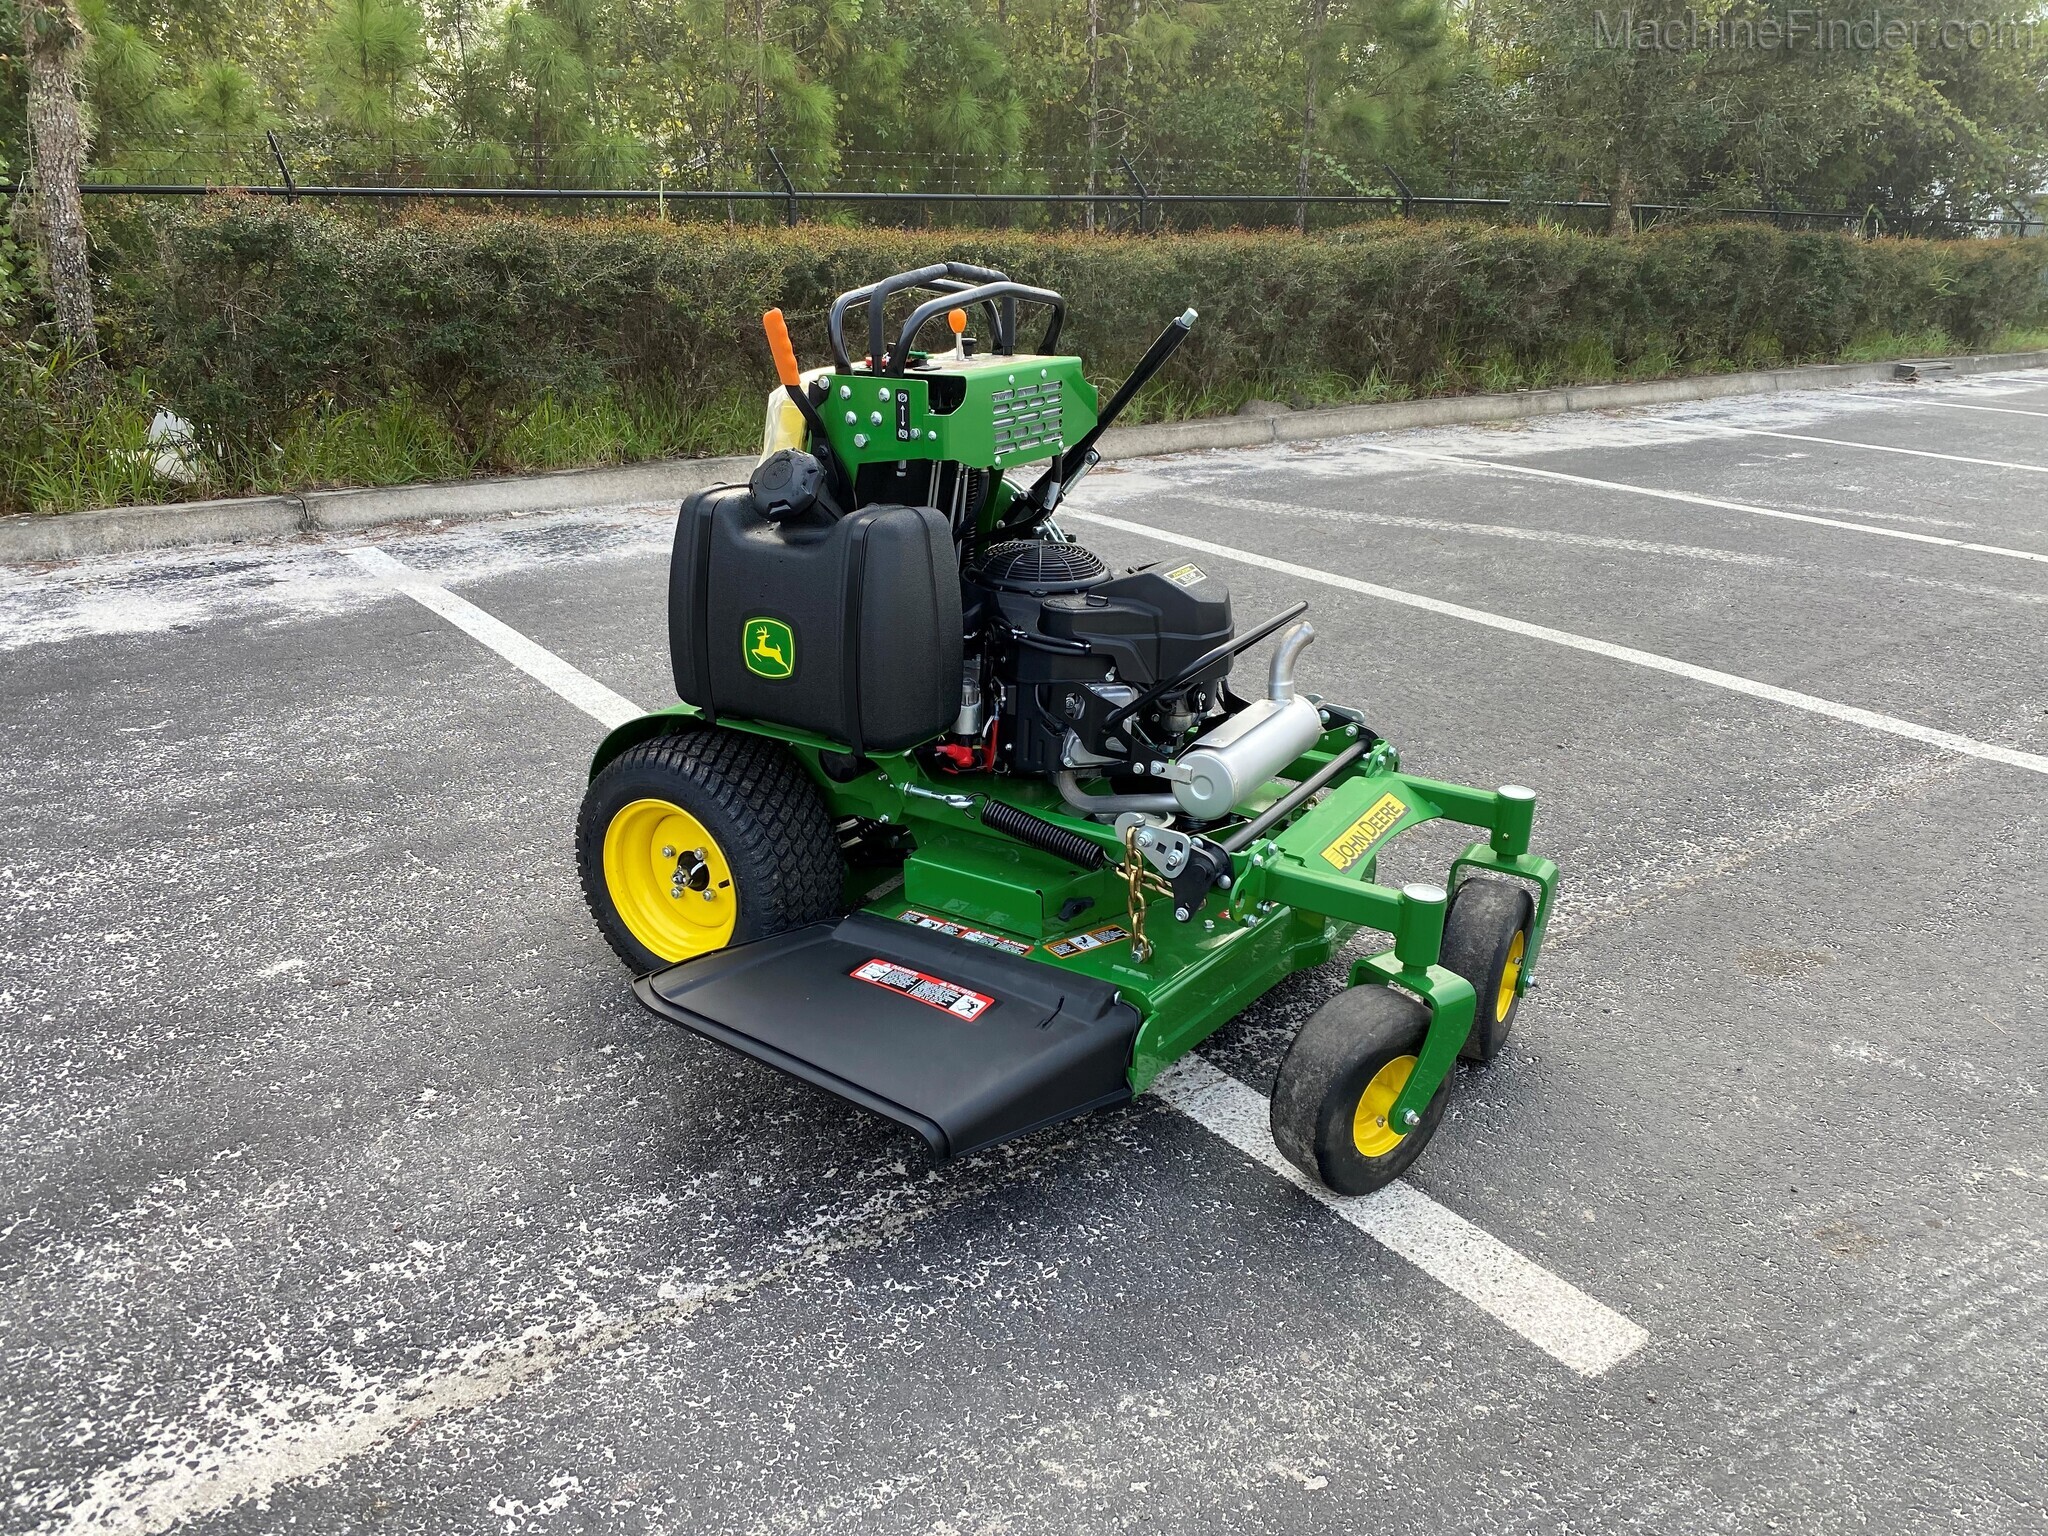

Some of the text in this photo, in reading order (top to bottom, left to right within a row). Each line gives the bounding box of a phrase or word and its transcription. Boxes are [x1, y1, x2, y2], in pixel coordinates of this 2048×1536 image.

[1332, 801, 1401, 865] JOHN DEERE
[891, 963, 919, 976] DANGER
